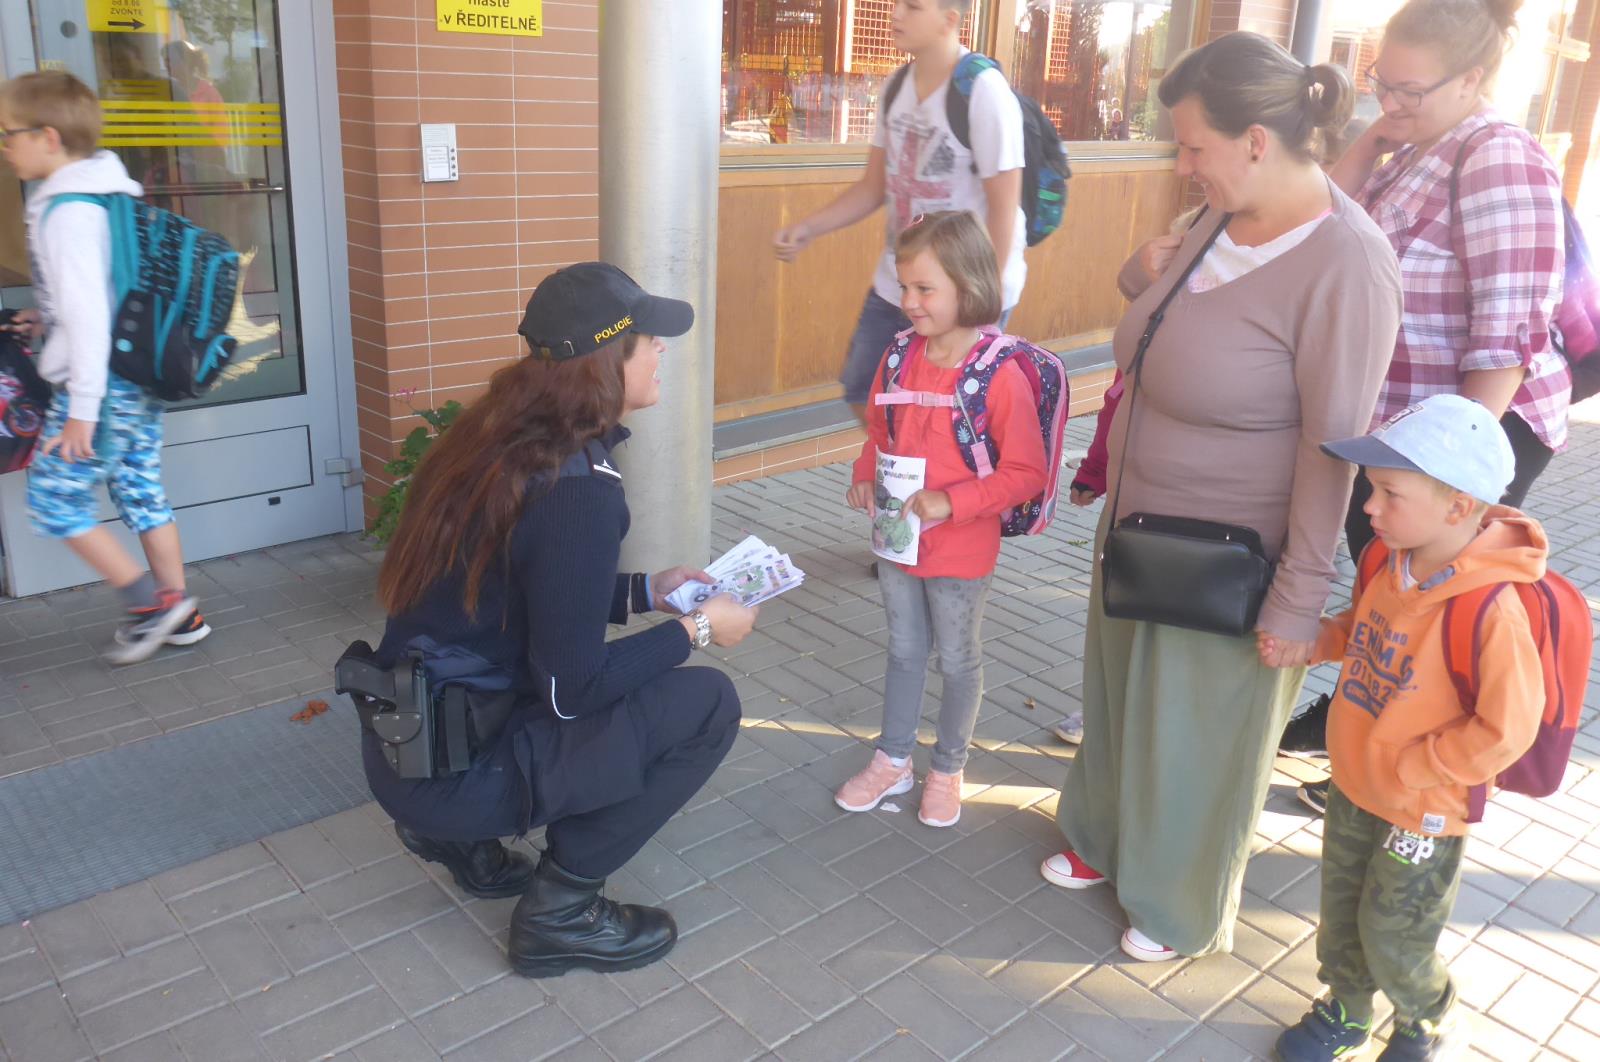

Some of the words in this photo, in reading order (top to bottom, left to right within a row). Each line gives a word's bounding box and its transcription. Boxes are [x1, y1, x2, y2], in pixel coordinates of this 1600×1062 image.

[110, 7, 144, 16] ZVONTE
[443, 14, 452, 24] v
[456, 9, 537, 31] ŘEDITELNĚ
[594, 314, 633, 344] POLICIE
